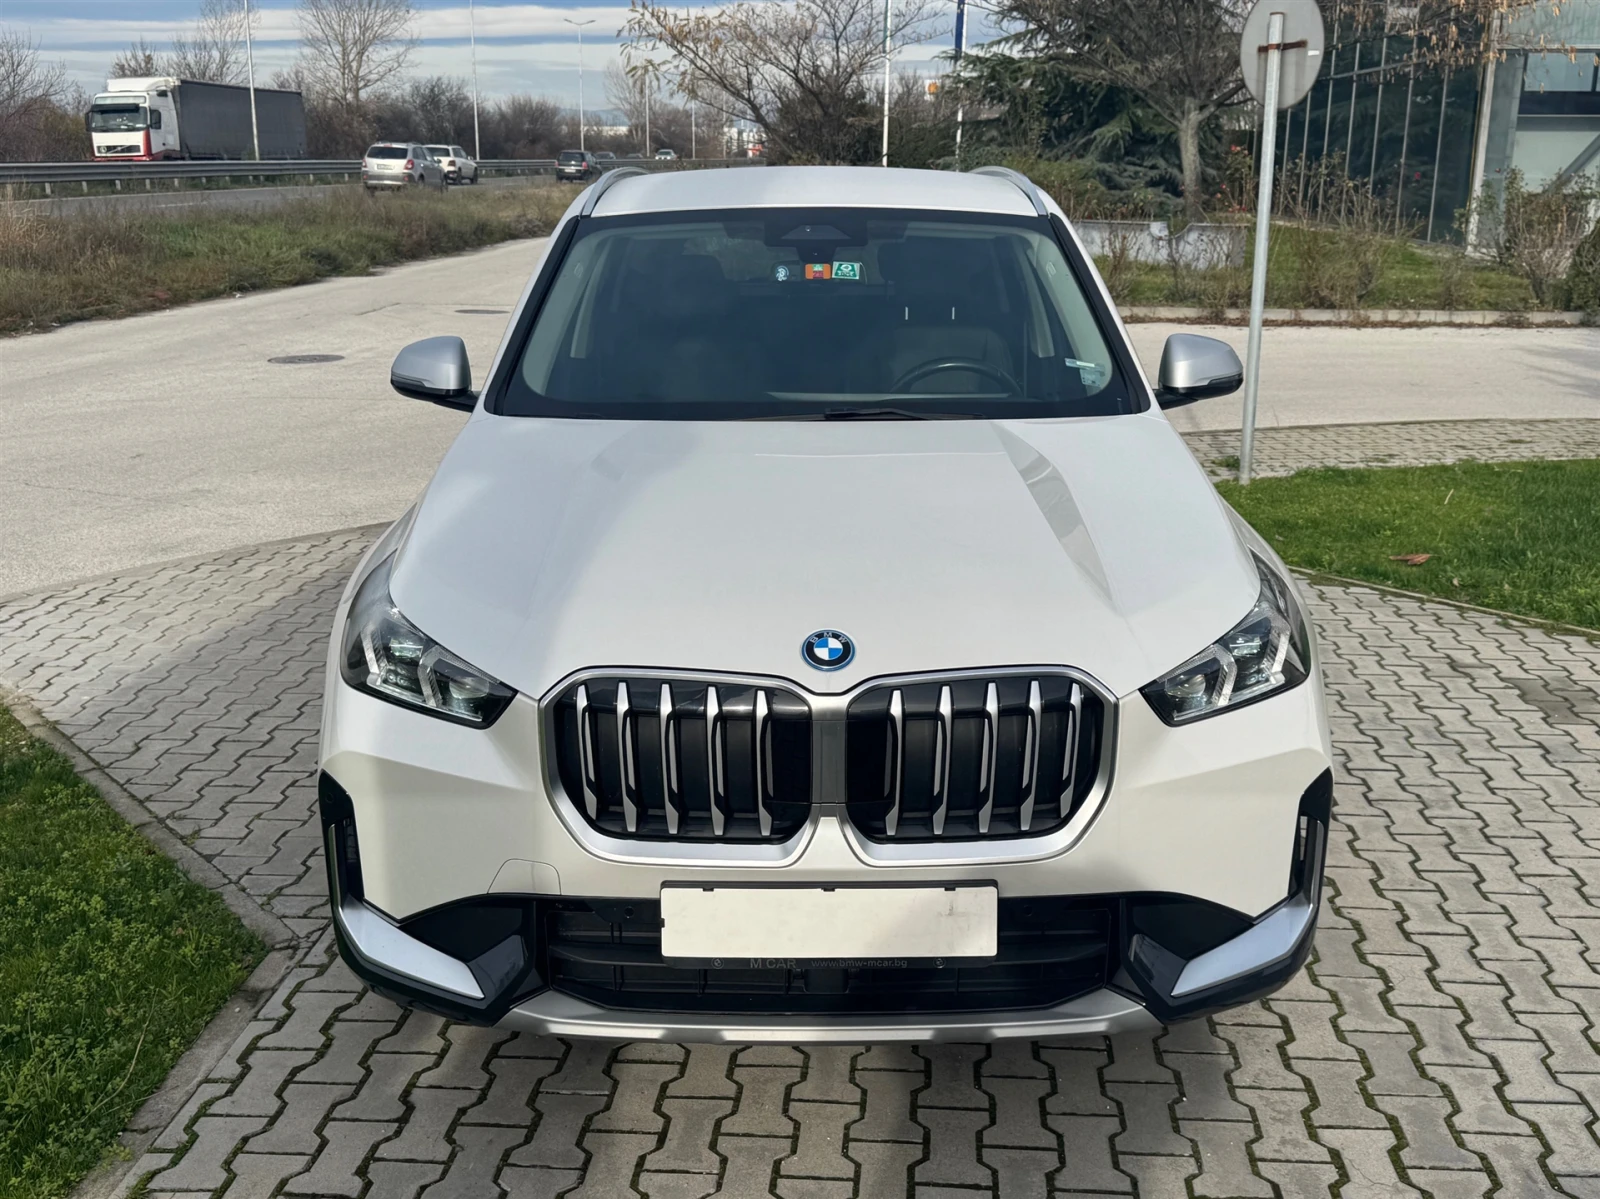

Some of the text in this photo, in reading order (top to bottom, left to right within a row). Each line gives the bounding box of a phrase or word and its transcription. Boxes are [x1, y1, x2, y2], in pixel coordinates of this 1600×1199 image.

[810, 632, 848, 643] BMW
[750, 958, 797, 969] M CAR
[811, 958, 908, 969] www.bmw-mcar.bg
